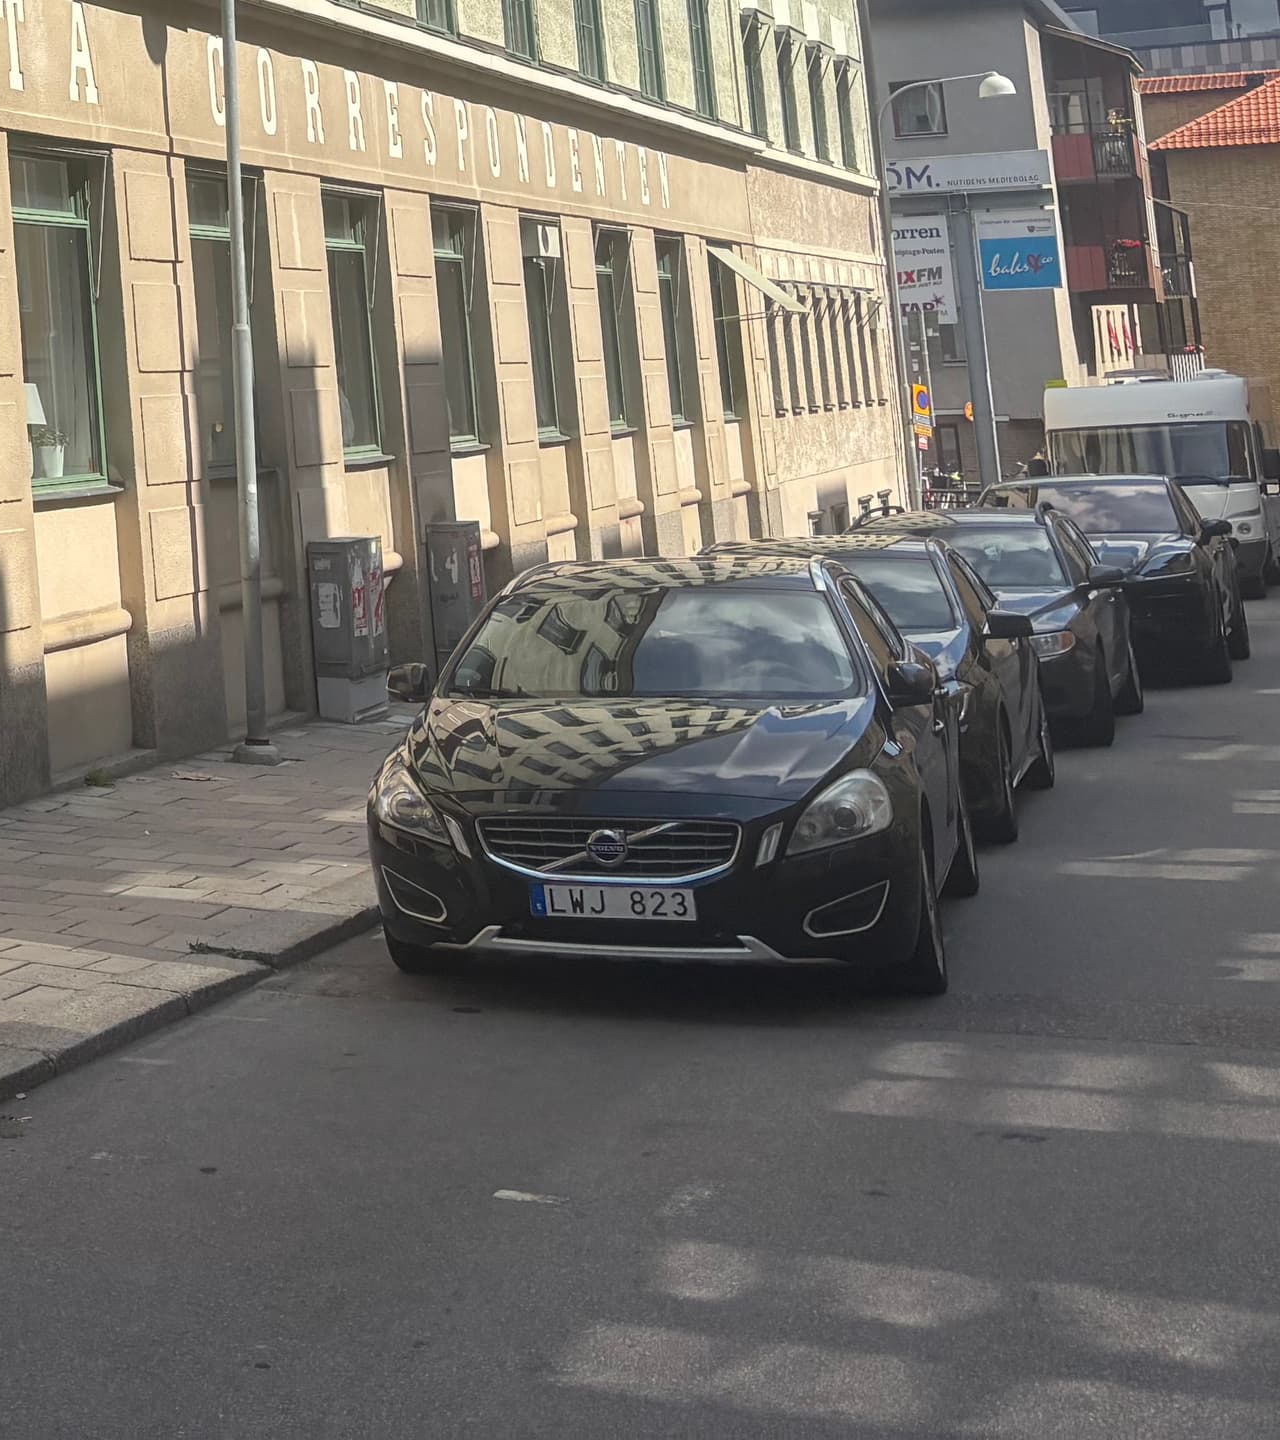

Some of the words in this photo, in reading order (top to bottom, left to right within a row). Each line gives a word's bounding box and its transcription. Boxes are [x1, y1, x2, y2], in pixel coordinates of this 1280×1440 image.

[207, 34, 671, 209] CORRESPONDENTEN
[548, 888, 606, 915] LWJ
[629, 890, 689, 917] 823
